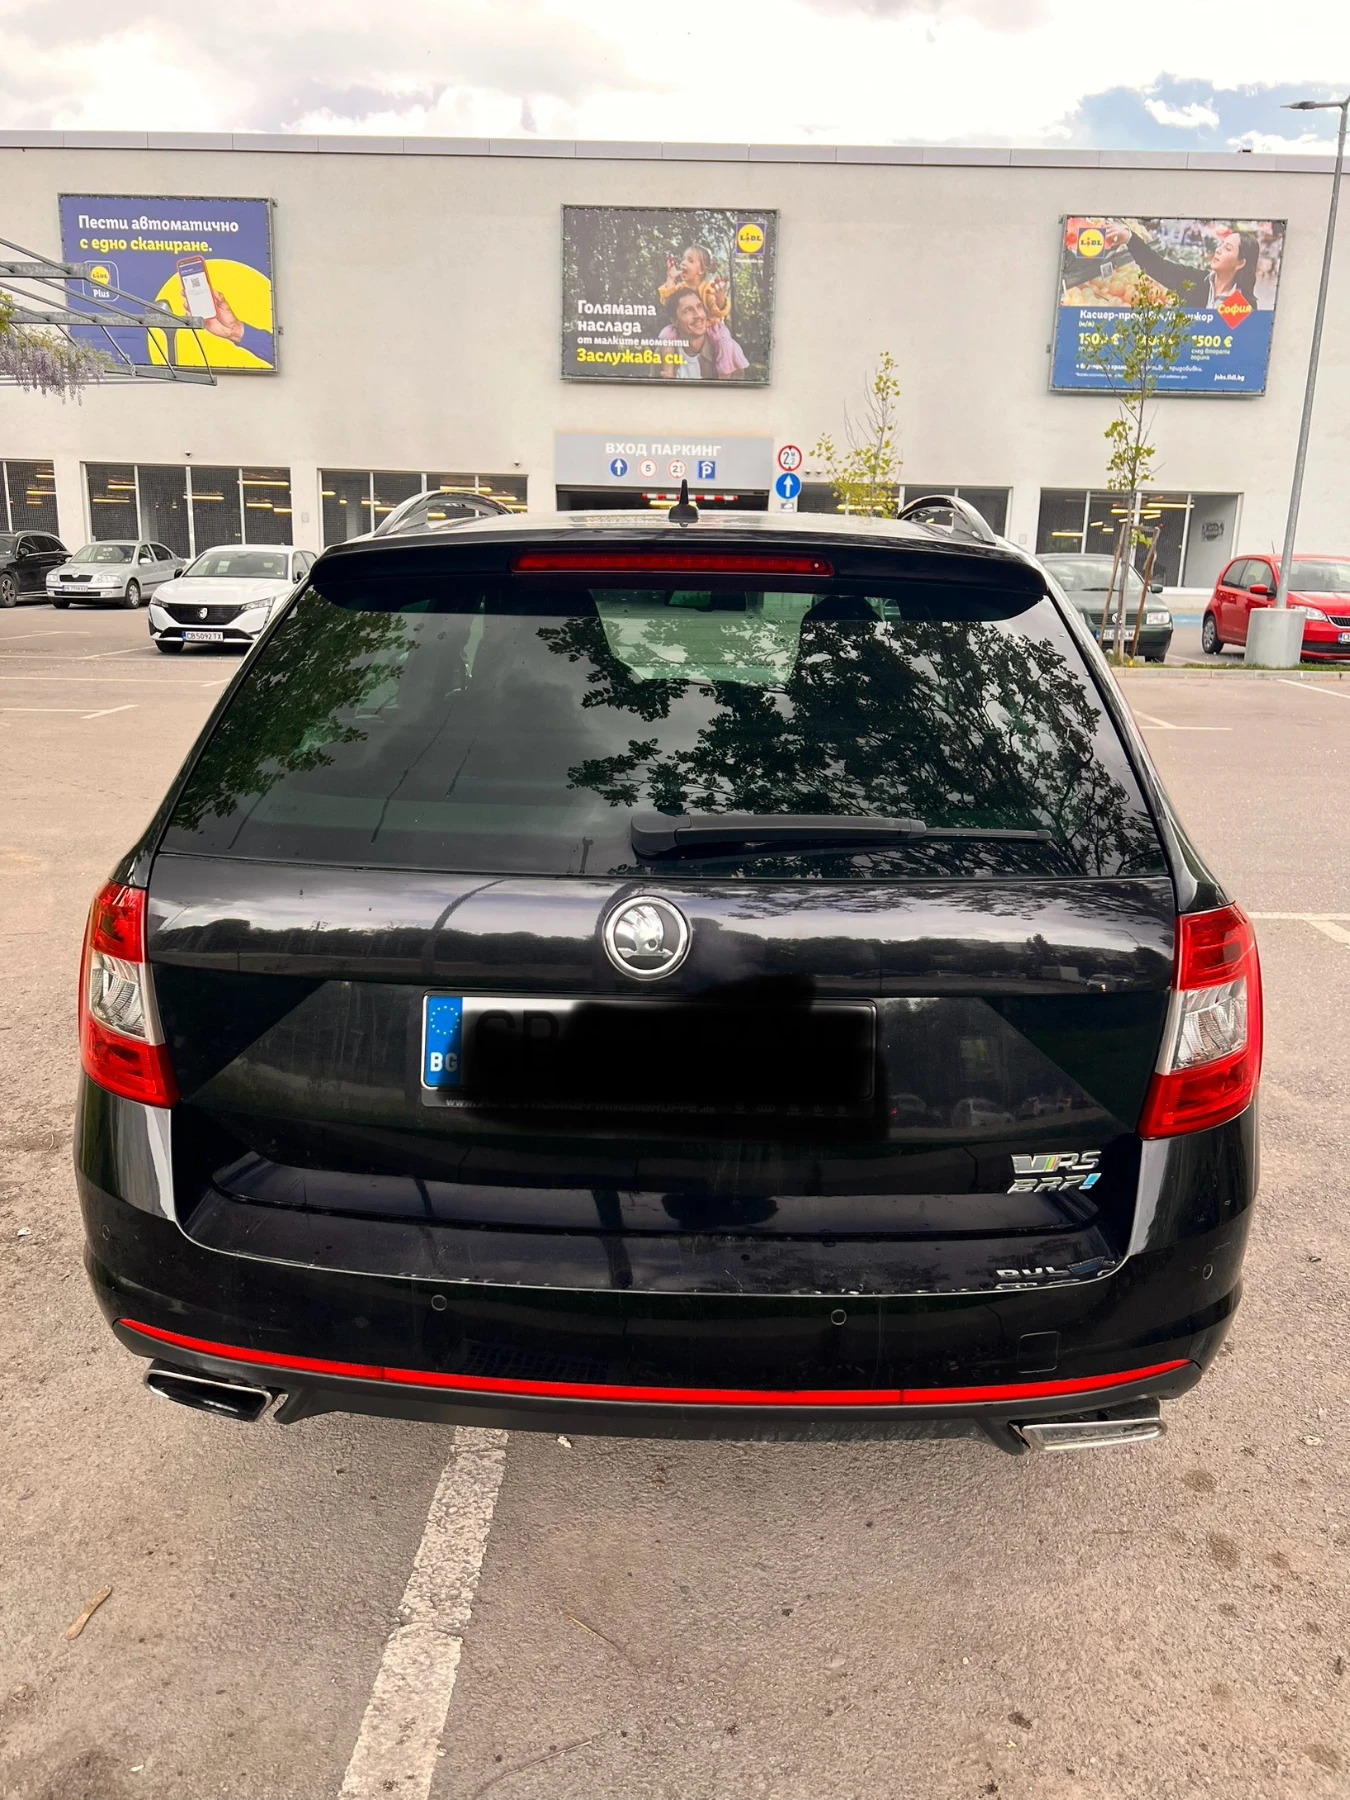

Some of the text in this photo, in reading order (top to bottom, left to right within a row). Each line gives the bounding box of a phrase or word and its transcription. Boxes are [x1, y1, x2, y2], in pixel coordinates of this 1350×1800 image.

[79, 215, 239, 232] Пести автоматично
[80, 236, 213, 254] с едно сканиране.
[93, 289, 110, 298] Plus
[577, 300, 657, 316] Голямата
[1217, 303, 1252, 317] София
[577, 320, 642, 336] наслада
[577, 335, 689, 347] от малките моменти
[576, 347, 662, 366] Заслужава
[605, 442, 722, 458] ВХОД ПАРКИНГ
[645, 464, 652, 472] 5
[430, 1051, 458, 1073] BG
